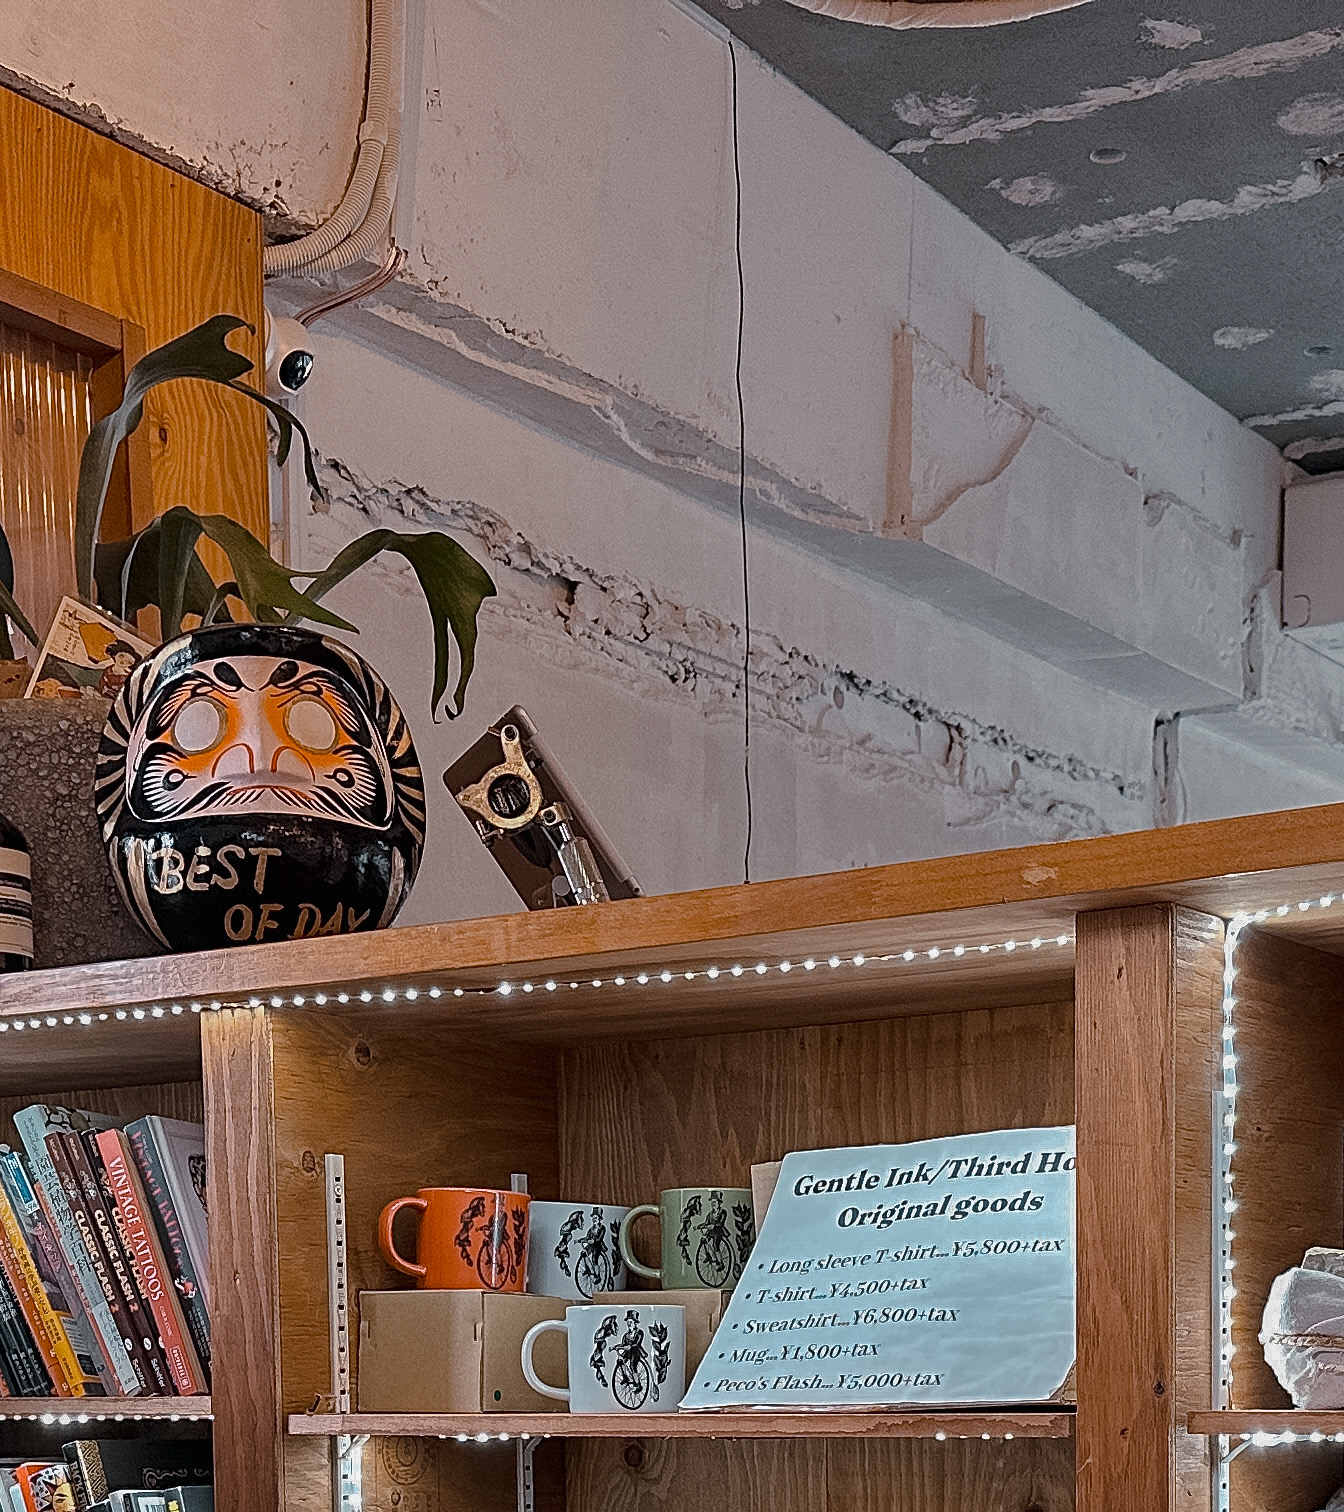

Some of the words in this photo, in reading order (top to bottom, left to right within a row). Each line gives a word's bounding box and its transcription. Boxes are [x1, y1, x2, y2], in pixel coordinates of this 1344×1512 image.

[152, 844, 282, 895] BEST
[224, 903, 284, 940] OF
[287, 902, 370, 938] DAY
[793, 1169, 880, 1198] Gentle
[885, 1152, 1031, 1187] Ink/Third
[109, 1157, 142, 1231] VINTAGE
[131, 1229, 165, 1302] TATTOOS
[837, 1194, 953, 1230] Original
[949, 1190, 1045, 1221] goods
[75, 1210, 99, 1262] CLASSIC
[93, 1261, 114, 1302] FLASH
[94, 1209, 119, 1261] CLASSIC
[113, 1260, 135, 1302] FLASH
[769, 1259, 812, 1275] Long
[814, 1253, 872, 1271] sleeve
[714, 1375, 768, 1393] Peco's
